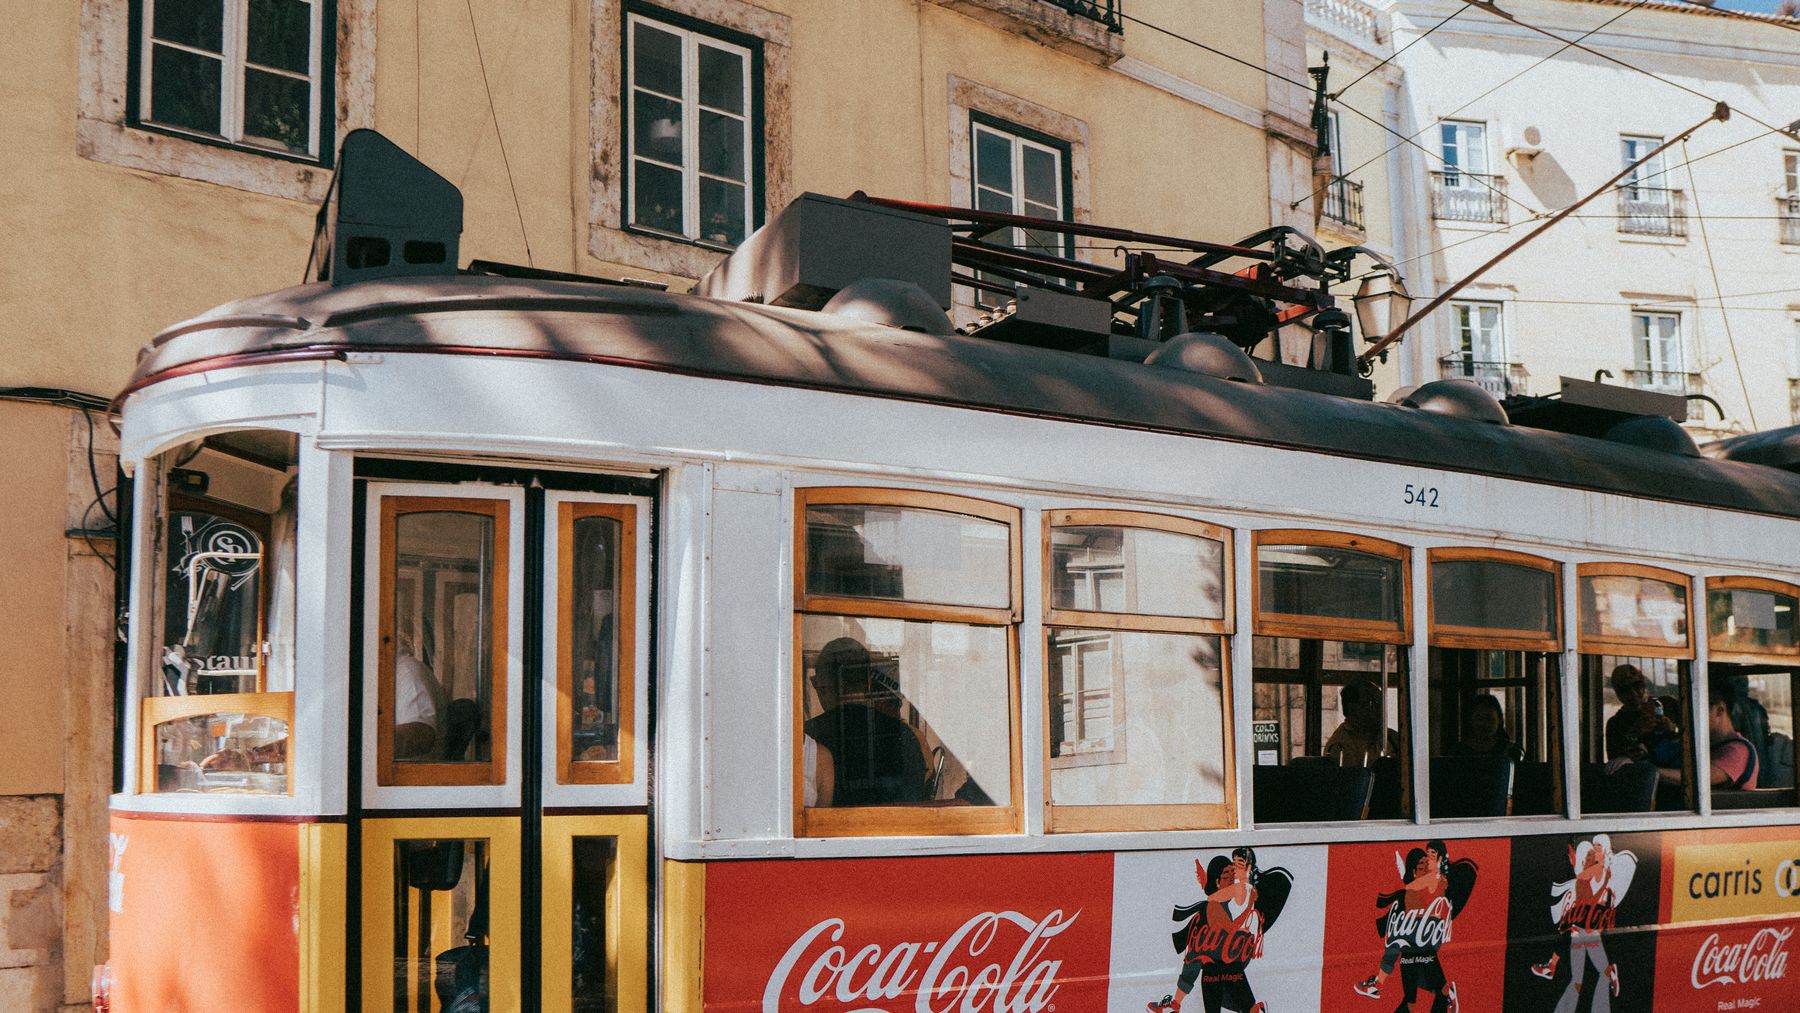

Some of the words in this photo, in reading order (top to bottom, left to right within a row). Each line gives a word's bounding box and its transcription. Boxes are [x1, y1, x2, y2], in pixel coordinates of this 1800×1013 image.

[1404, 484, 1439, 507] 542
[1255, 724, 1276, 733] COLD
[1253, 733, 1279, 743] DRINKS
[1689, 859, 1762, 899] carris
[762, 907, 1083, 1013] Coca-Cola
[1415, 955, 1435, 963] Magic
[1691, 927, 1795, 989] Coca-Cola
[1203, 974, 1219, 983] Real
[1222, 973, 1243, 982] Magic
[1717, 1000, 1736, 1011] Real
[1737, 997, 1761, 1009] Magic
